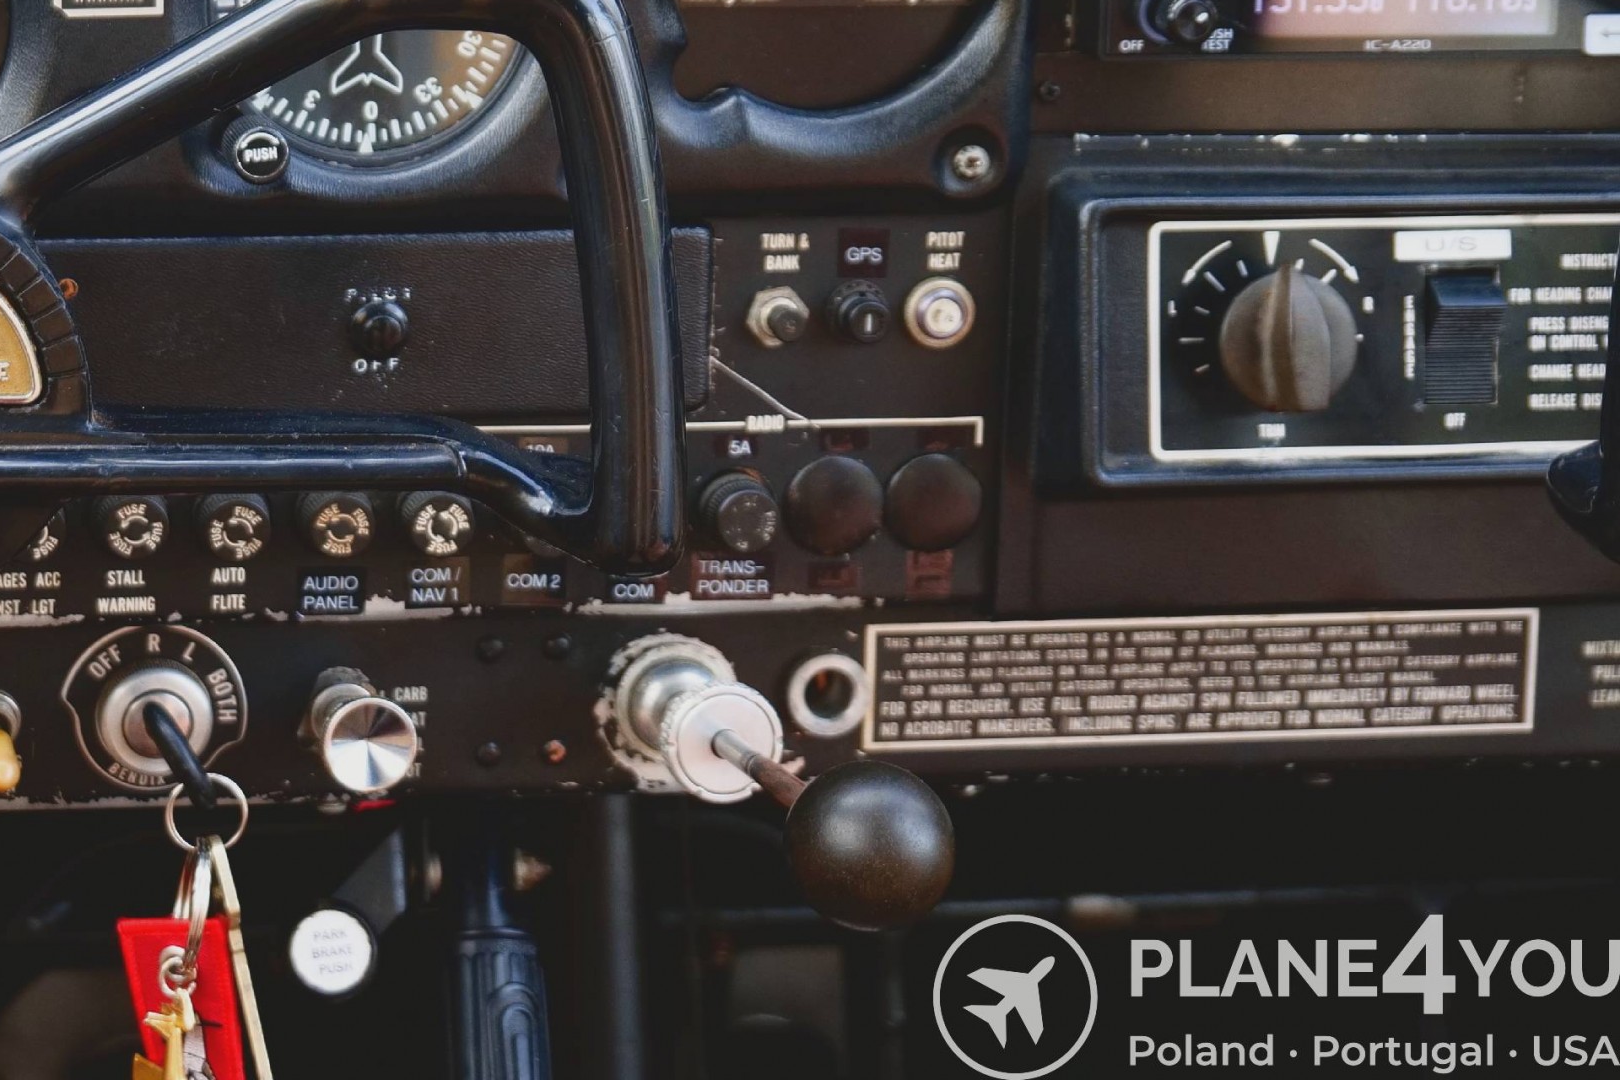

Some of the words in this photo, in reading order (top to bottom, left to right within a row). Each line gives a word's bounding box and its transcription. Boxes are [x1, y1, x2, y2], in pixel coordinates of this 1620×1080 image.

[245, 147, 277, 162] PUSH
[761, 233, 795, 250] TURN
[799, 233, 810, 250] &
[926, 231, 965, 248] PITOT
[846, 246, 883, 263] GPS
[928, 253, 961, 270] HEAT
[764, 255, 800, 272] BANK
[1551, 334, 1598, 349] CONTROL
[700, 560, 764, 574] TRANS-
[36, 572, 61, 588] ACC
[108, 570, 145, 586] STALL
[213, 567, 245, 584] AUTO
[304, 576, 358, 590] AUDIO
[412, 568, 448, 583] COM
[507, 574, 544, 589] COM
[549, 574, 561, 588] 2
[412, 587, 446, 602] NAV
[452, 587, 459, 601] 1
[614, 583, 653, 598] COM
[698, 579, 768, 594] PONDER
[32, 599, 55, 615] LGT
[99, 597, 155, 614] WARNING
[212, 593, 245, 610] FLITE
[304, 595, 358, 610] PANEL
[148, 634, 160, 652] R
[89, 643, 122, 680] OFF
[206, 668, 237, 722] BOTH
[395, 686, 428, 702] CARB
[1051, 696, 1081, 712] FULL
[1087, 695, 1137, 712] RUDDER
[1142, 693, 1195, 710] AGAINST
[904, 720, 972, 737] ACROBATIC
